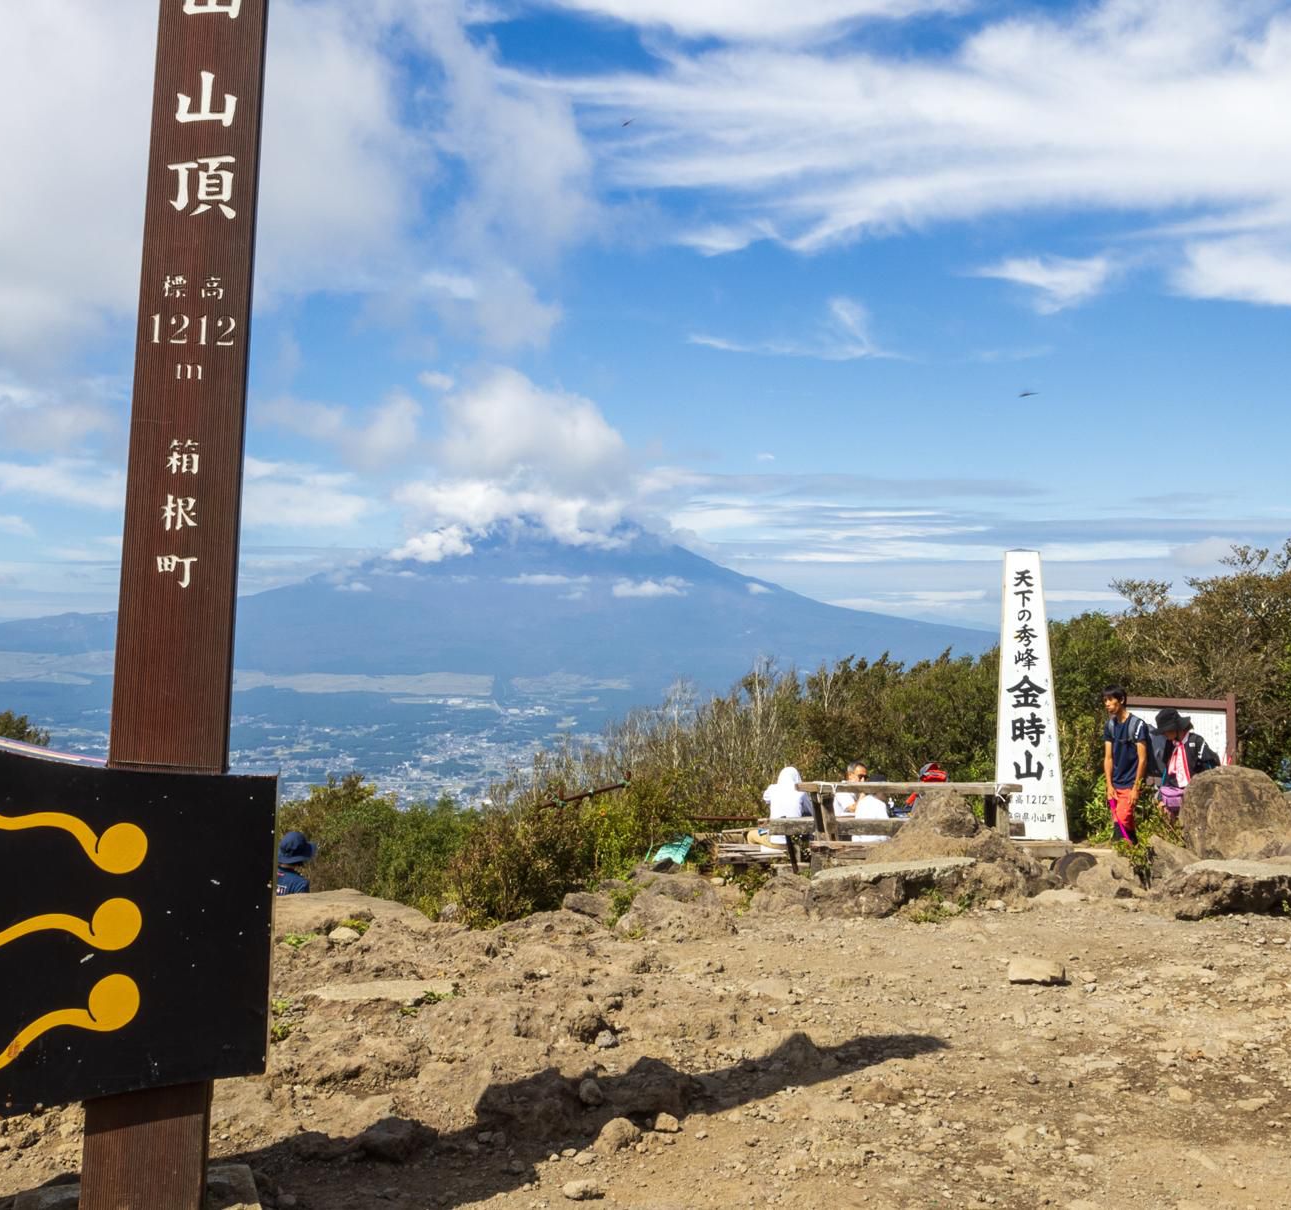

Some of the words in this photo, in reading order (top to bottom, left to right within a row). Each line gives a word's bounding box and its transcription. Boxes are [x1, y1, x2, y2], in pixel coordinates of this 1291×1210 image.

[163, 275, 225, 300] 標高
[148, 313, 237, 347] 1212
[175, 363, 203, 381] m
[156, 438, 201, 589] 箱根町
[1013, 568, 1039, 671] 天下の秀峰
[1006, 674, 1048, 782] 金時山
